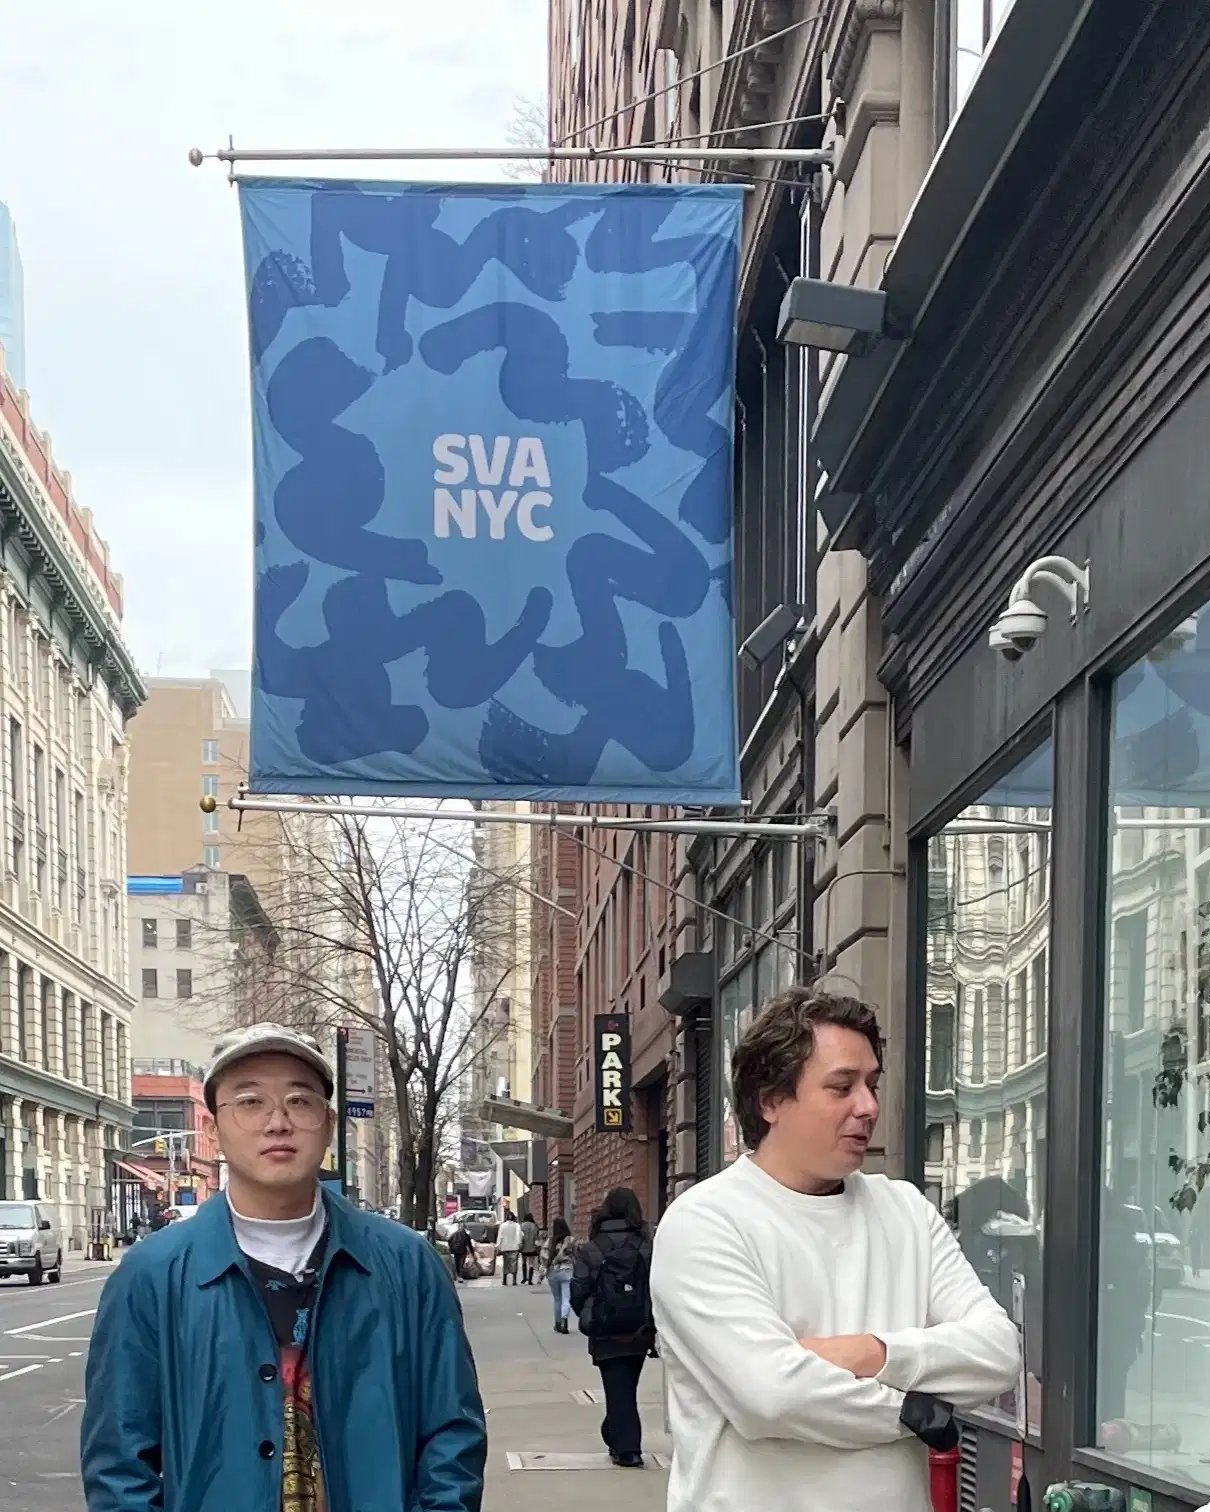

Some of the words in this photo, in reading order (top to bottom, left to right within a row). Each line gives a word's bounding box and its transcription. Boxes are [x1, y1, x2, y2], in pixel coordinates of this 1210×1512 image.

[432, 433, 551, 488] SVA
[433, 487, 554, 542] NYC
[601, 1033, 623, 1107] PARK
